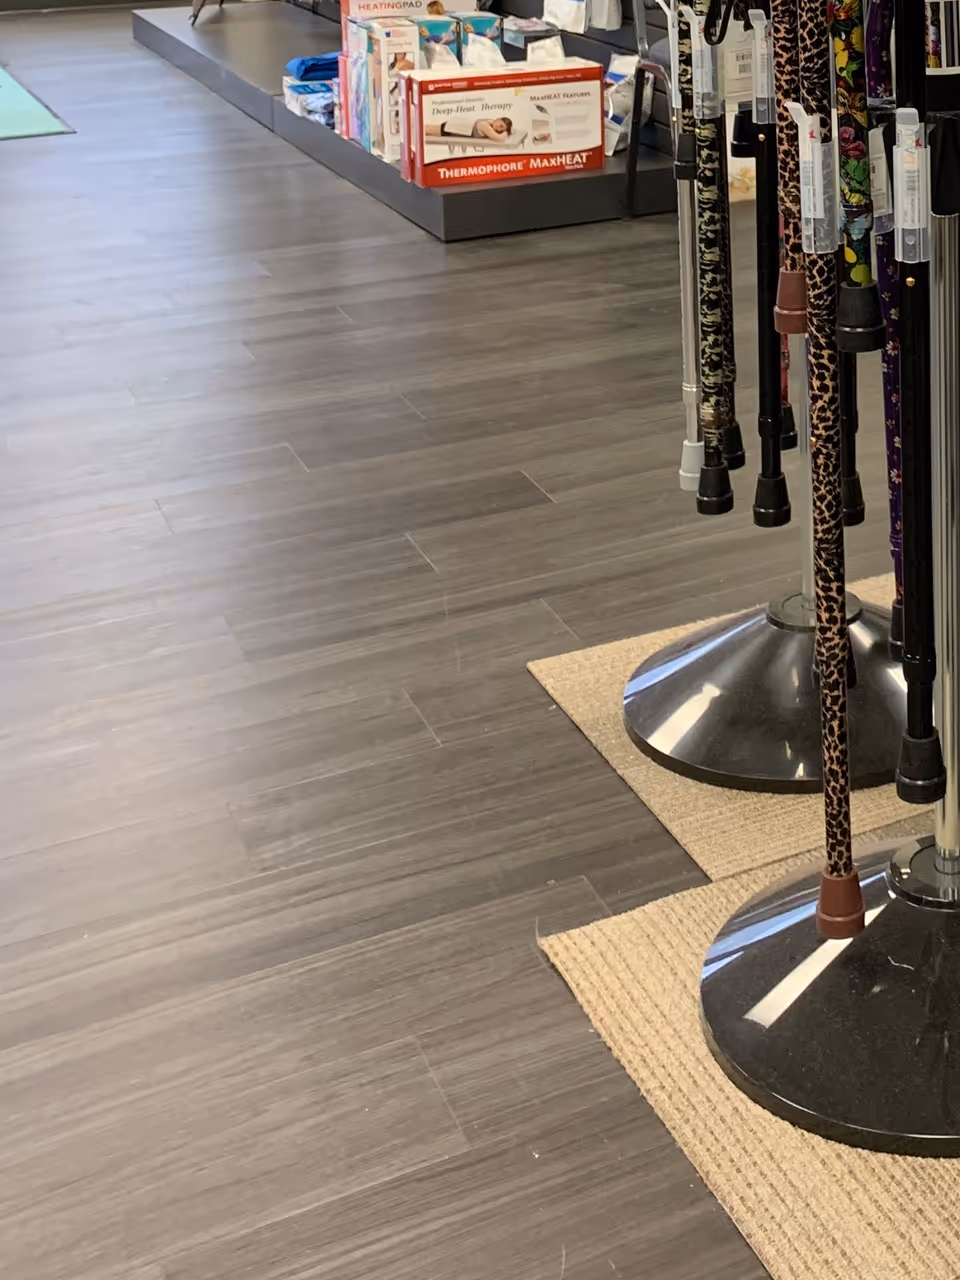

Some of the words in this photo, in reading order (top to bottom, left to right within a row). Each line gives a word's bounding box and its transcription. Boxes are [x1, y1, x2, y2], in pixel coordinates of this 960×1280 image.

[358, 0, 423, 12] HEATINGPAD
[432, 105, 475, 116] Deep-Heat
[481, 101, 514, 113] Therapy
